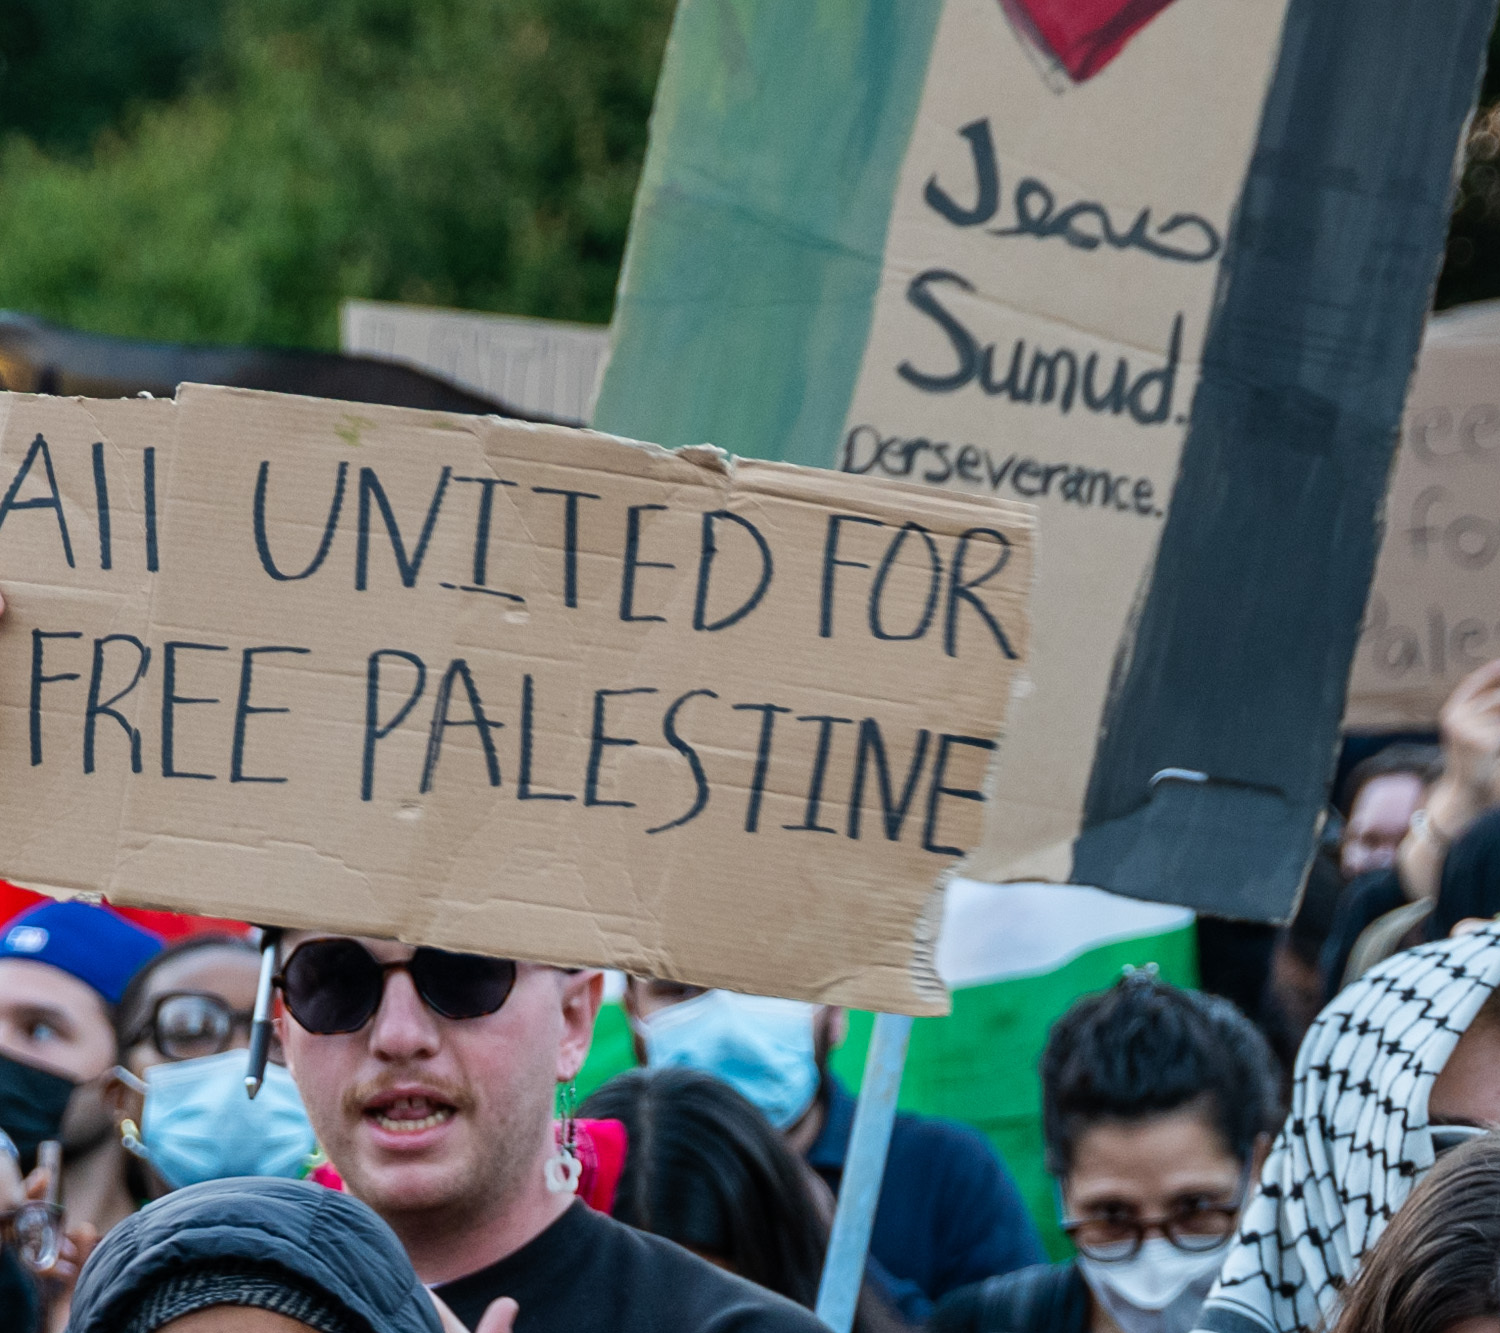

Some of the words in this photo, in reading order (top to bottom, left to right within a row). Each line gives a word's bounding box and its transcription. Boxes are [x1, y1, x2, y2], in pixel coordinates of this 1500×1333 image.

[898, 268, 1191, 426] Sumud.
[252, 459, 774, 632] UNITED
[818, 514, 1019, 660] FOR
[29, 627, 312, 783] FREE
[360, 647, 999, 857] PALESTINE
